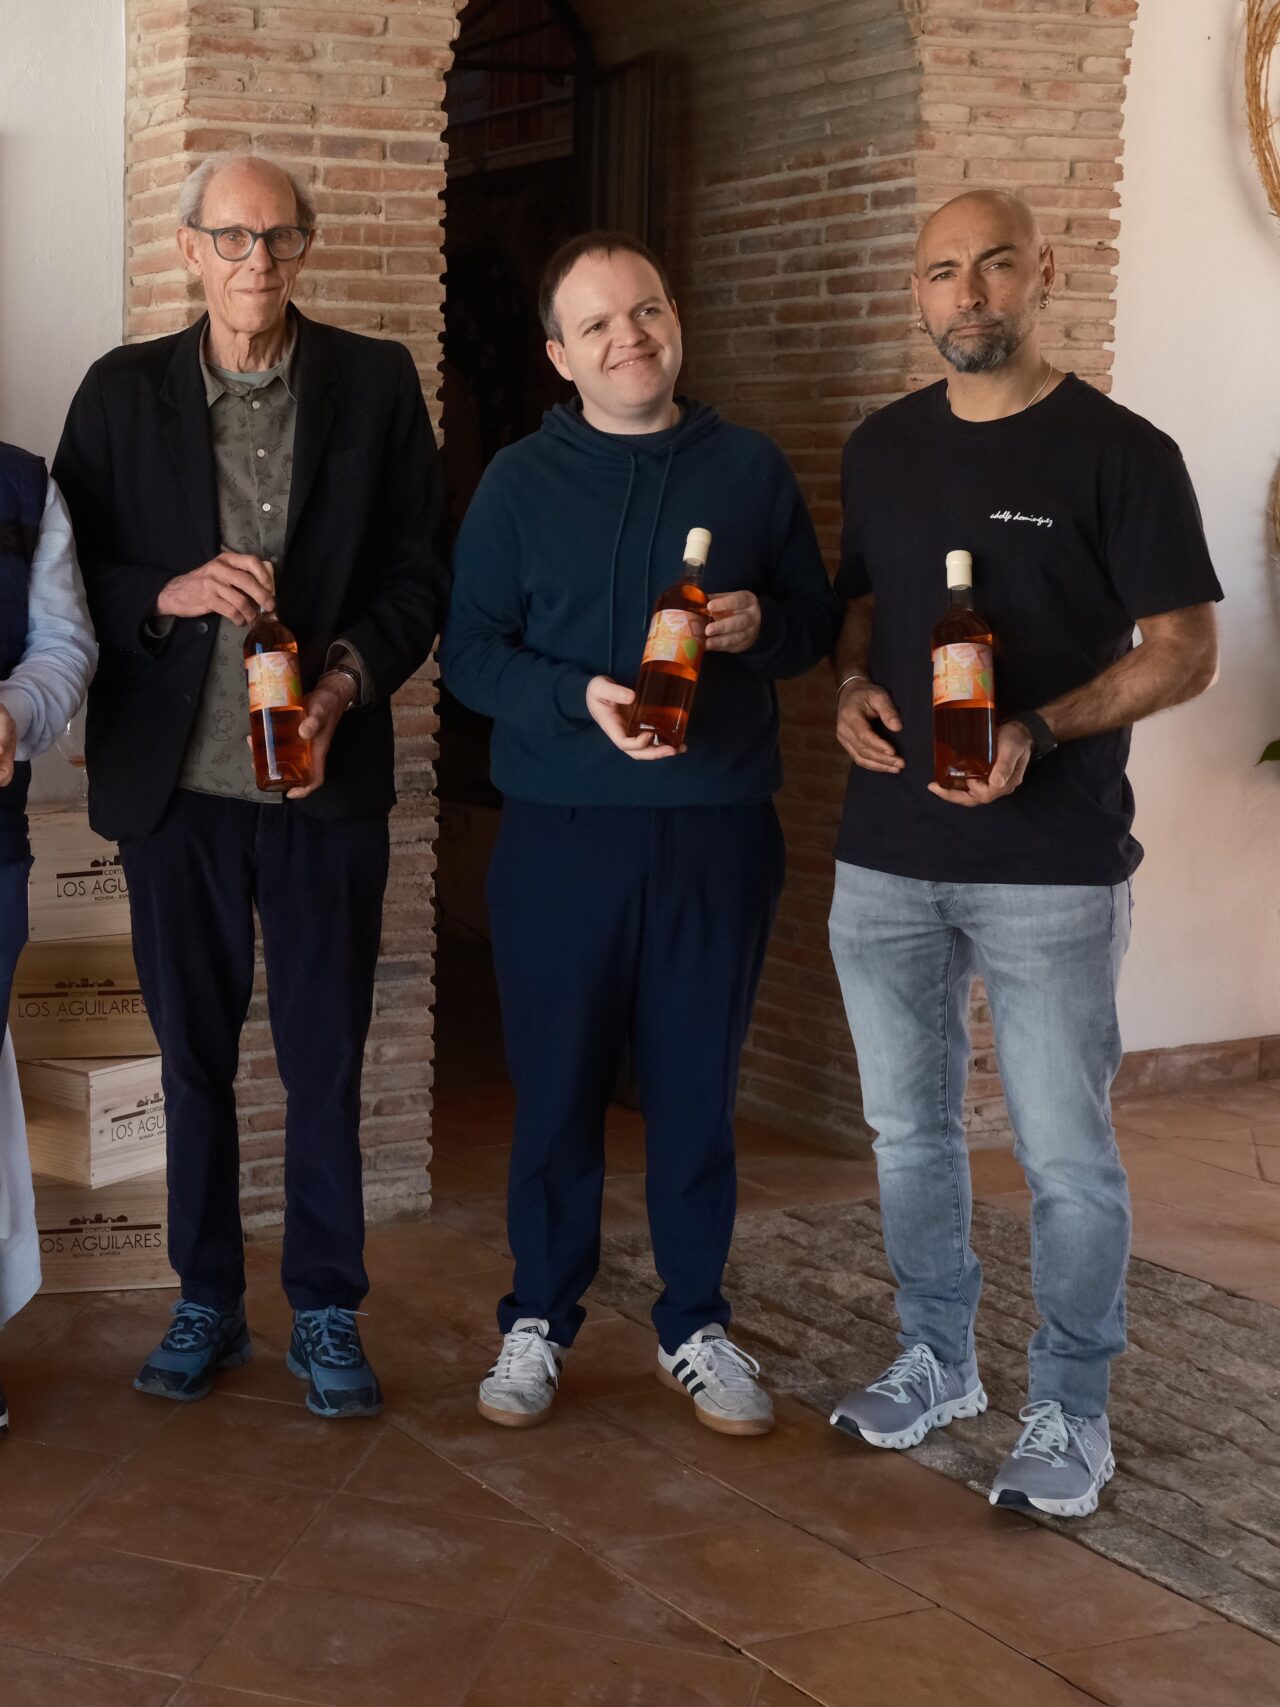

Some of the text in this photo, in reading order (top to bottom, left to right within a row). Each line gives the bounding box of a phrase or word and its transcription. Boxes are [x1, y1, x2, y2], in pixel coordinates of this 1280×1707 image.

[56, 878, 129, 898] LOS AGU
[18, 1002, 50, 1018] LOS
[111, 1113, 165, 1142] LOS AGU
[40, 1232, 162, 1253] OS AGUILARES
